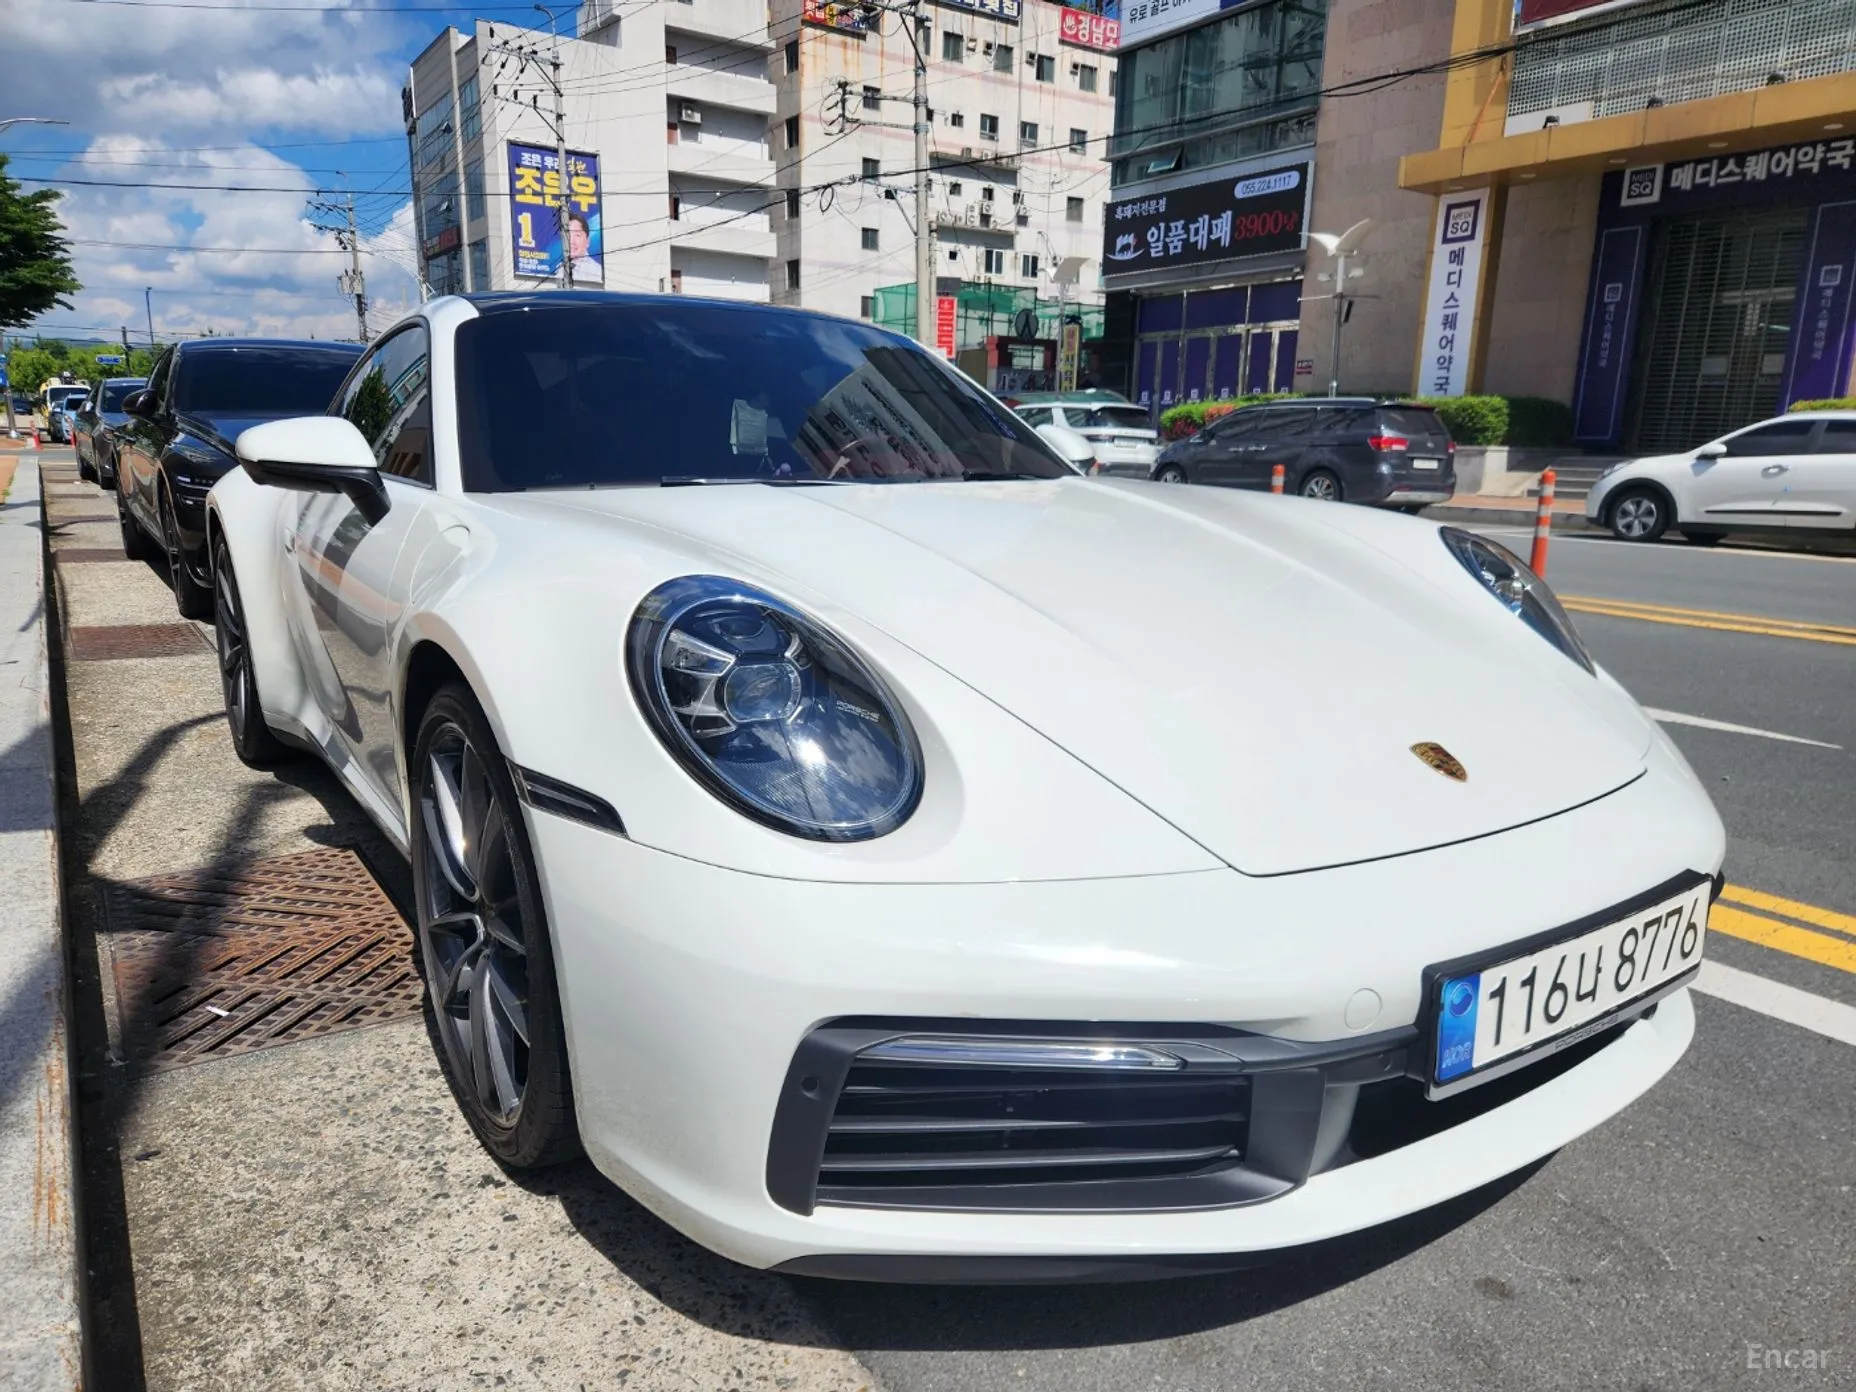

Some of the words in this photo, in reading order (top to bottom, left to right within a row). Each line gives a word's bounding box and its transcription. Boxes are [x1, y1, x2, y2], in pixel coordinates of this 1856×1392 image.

[1129, 4, 1148, 24] 유로
[521, 153, 542, 168] 조은
[1632, 171, 1655, 182] MEDI
[1670, 139, 1856, 191] 메디스퀘어약국
[514, 167, 598, 213] 조은우
[1630, 182, 1653, 196] SQ
[518, 212, 535, 248] 1
[1146, 210, 1233, 258] 일품대패
[1234, 210, 1300, 241] 3900냥
[1449, 220, 1471, 235] SQ
[1433, 246, 1466, 395] 메디스퀘어약국
[1487, 944, 1604, 1047] 116나
[1614, 896, 1699, 994] 8776
